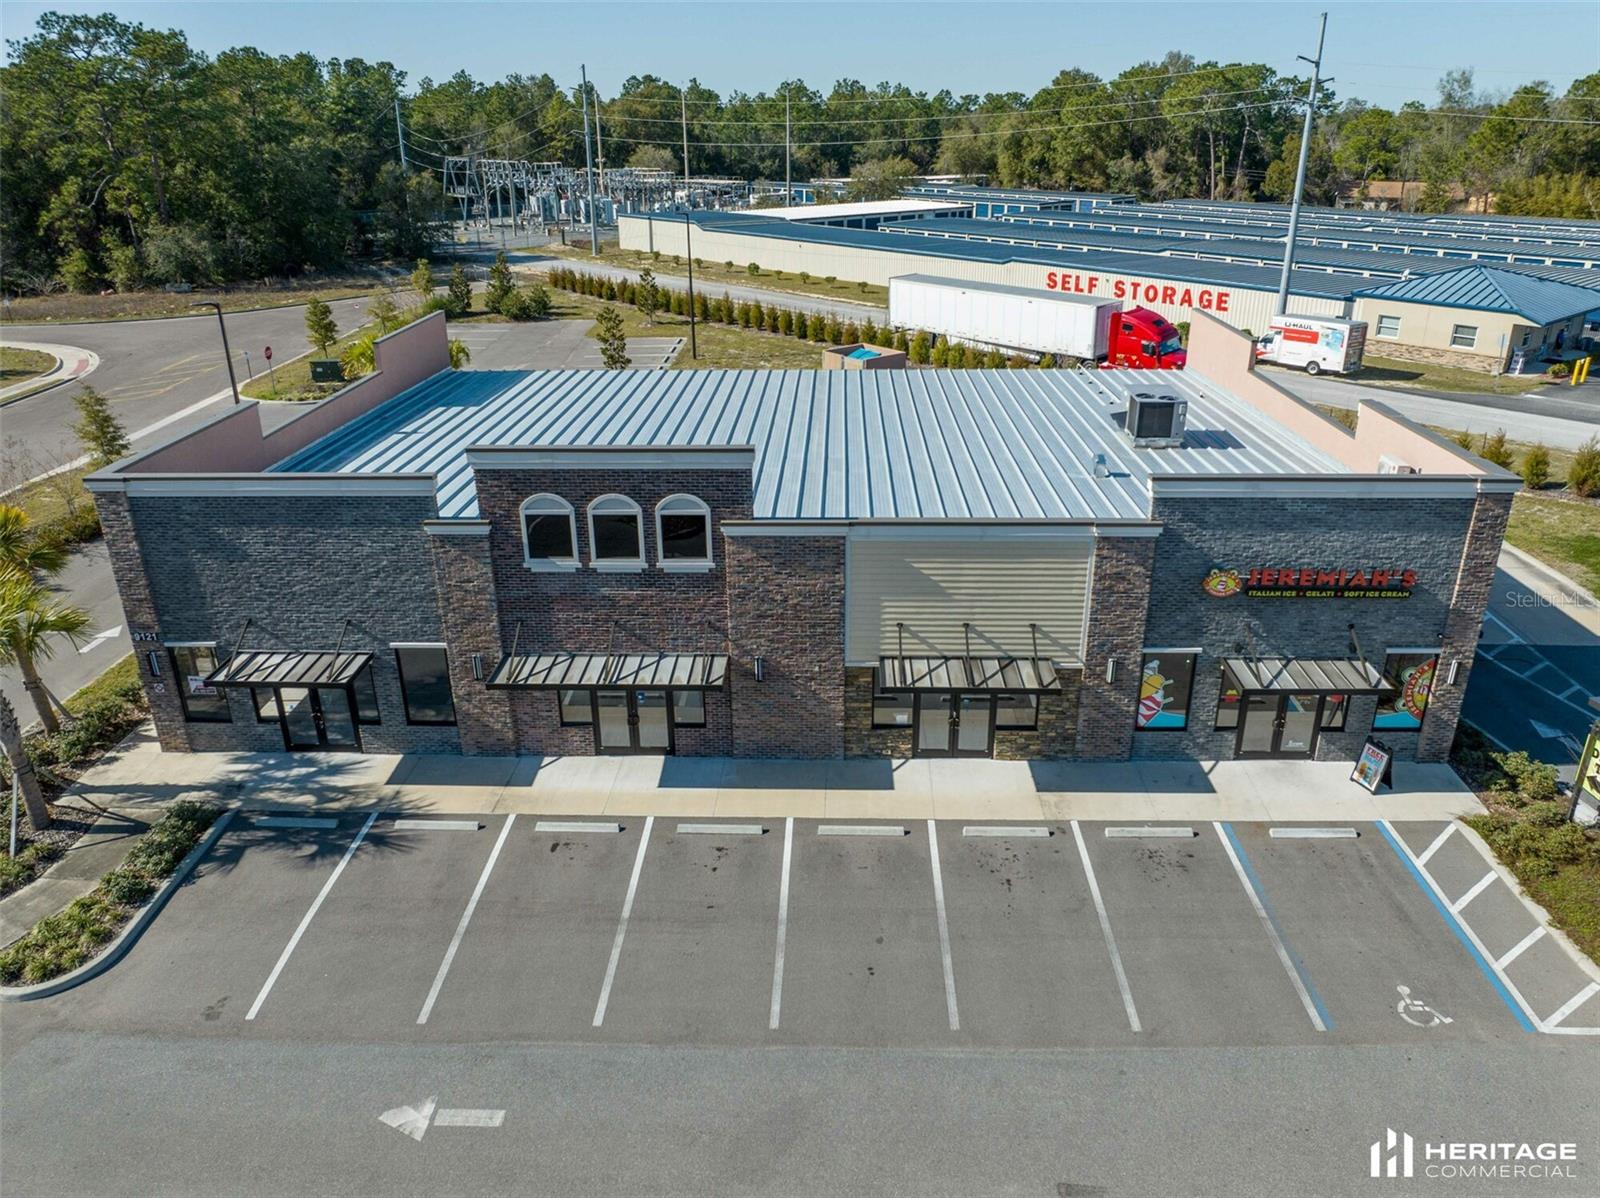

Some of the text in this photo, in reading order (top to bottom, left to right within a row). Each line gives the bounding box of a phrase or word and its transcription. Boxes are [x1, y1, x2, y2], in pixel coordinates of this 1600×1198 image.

[1046, 272, 1230, 312] SELF STORAGE
[1247, 568, 1417, 587] JEREMIAH'S
[134, 632, 157, 641] 9121
